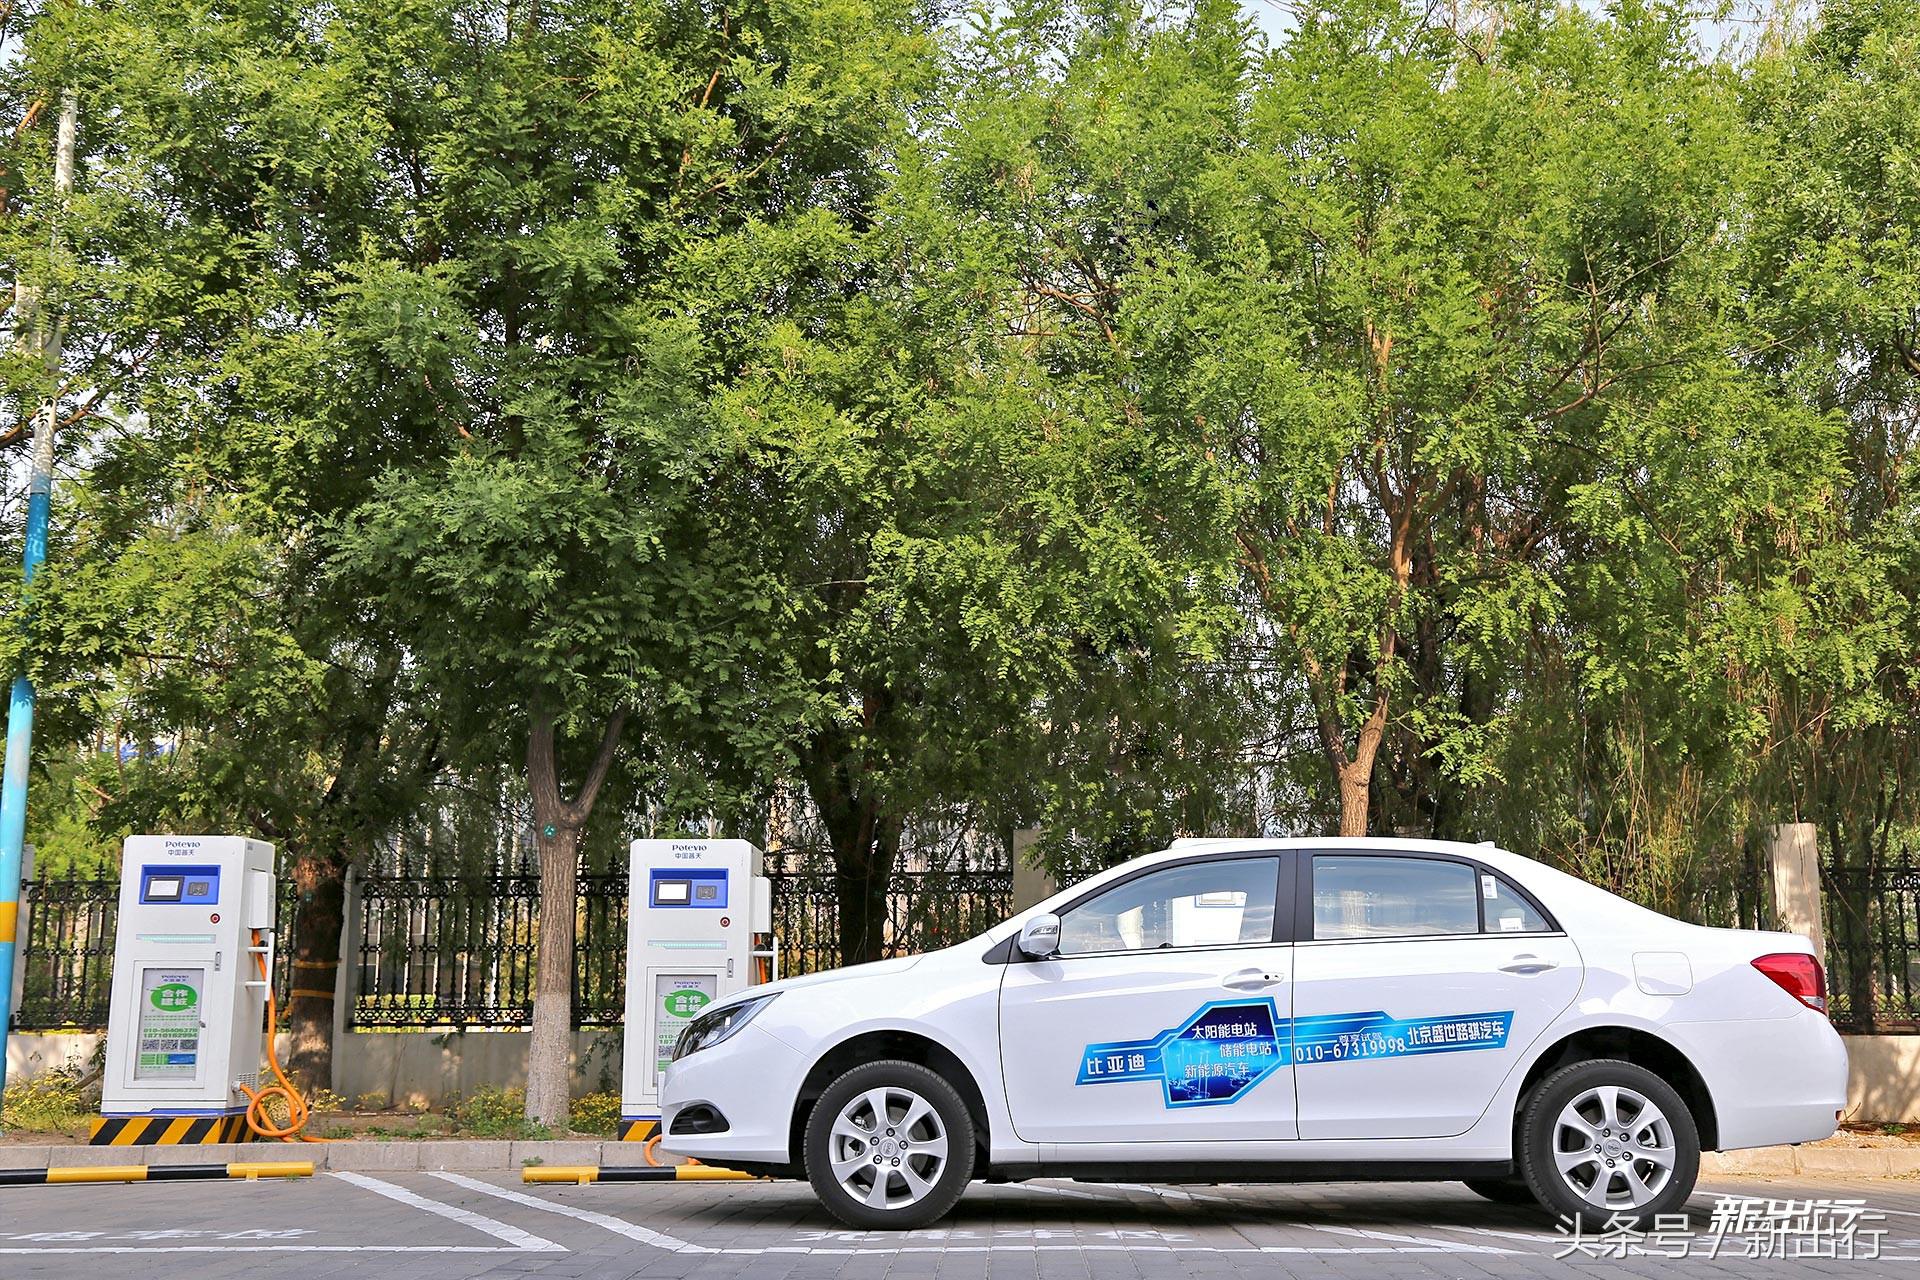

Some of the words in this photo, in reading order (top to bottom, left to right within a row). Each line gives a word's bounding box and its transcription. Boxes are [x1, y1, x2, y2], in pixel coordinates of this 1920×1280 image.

[675, 995, 702, 1003] 合作
[1191, 1022, 1257, 1040] 太阳能电站
[1219, 1041, 1272, 1058] 储能电站
[1296, 1037, 1406, 1062] 010-67319998
[1086, 1054, 1146, 1075] 比亚迪
[1184, 1062, 1250, 1079] 新能源汽车
